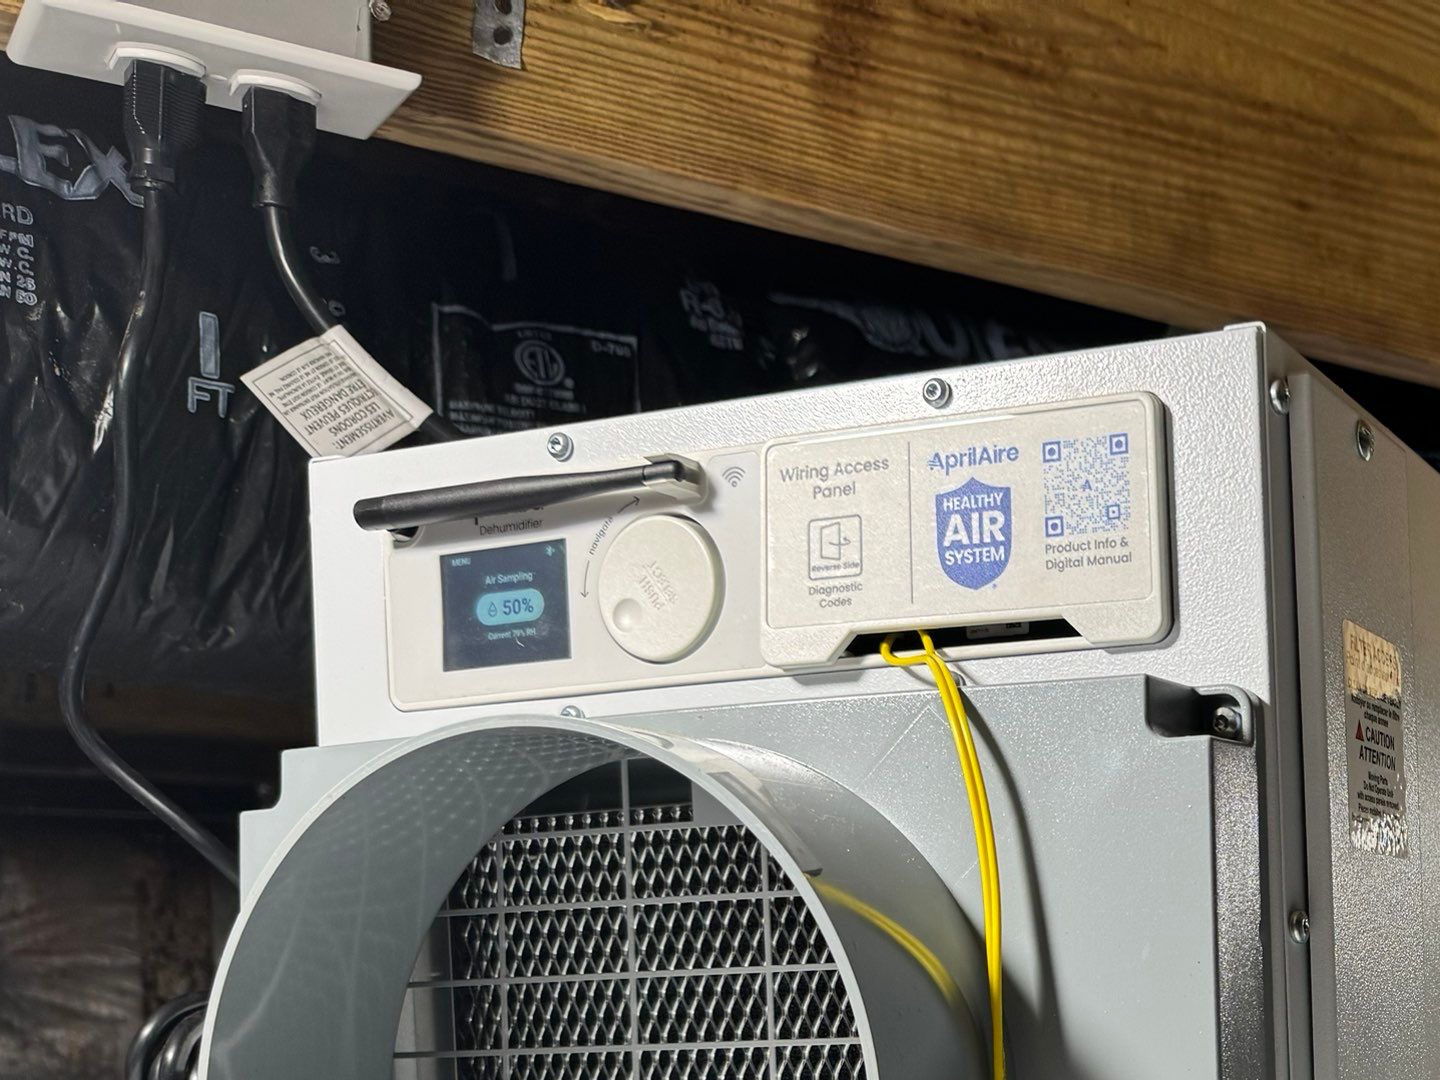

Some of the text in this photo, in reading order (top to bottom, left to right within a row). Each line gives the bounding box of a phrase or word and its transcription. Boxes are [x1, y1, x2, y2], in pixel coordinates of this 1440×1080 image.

[188, 377, 235, 418] FT
[301, 388, 348, 420] DANGEREUX
[304, 409, 340, 436] PEUVENT
[328, 401, 381, 437] LES CORDONS
[332, 409, 395, 450] AVERTISSEMENT:
[780, 458, 890, 482] Wiring Access
[927, 445, 1019, 476] AprilAire
[813, 481, 856, 499] Panel
[943, 492, 1004, 512] HEALTHY
[479, 519, 543, 536] Dehumidifier
[588, 516, 614, 556] navigate
[943, 510, 1005, 547] AIR
[944, 544, 1005, 566] SYSTEM
[1045, 536, 1129, 554] Product Info &
[811, 561, 860, 572] Reverse Side
[1045, 551, 1133, 573] Digital Manual
[485, 570, 534, 585] Air Sampling
[808, 582, 863, 597] Diagnostic
[502, 597, 534, 615] 50%
[819, 597, 853, 608] Codes
[1365, 726, 1395, 751] CAUTION
[1359, 745, 1396, 771] ATTENTION
